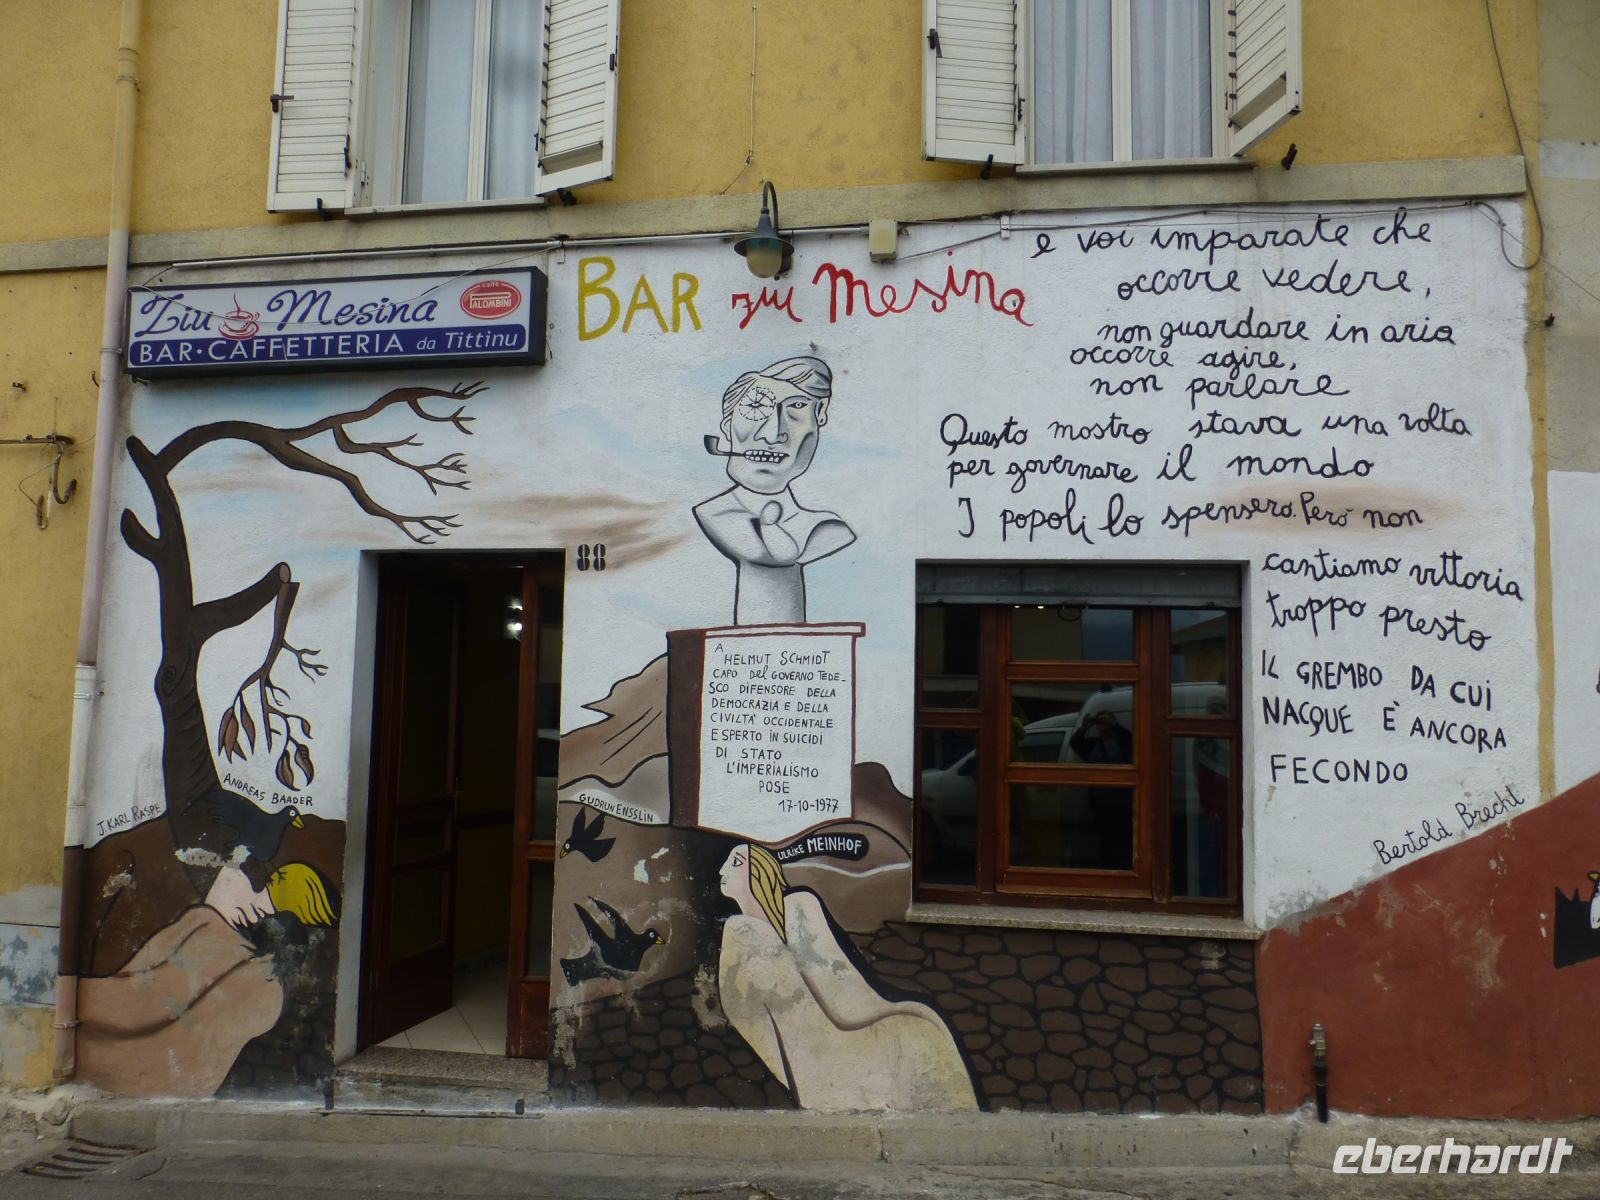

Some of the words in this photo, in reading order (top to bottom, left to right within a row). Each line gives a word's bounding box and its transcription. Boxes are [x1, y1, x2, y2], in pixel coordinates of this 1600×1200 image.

[1077, 229, 1134, 253] voi
[1150, 213, 1349, 265] imparate
[1373, 207, 1432, 245] che
[1117, 265, 1241, 300] occorre
[134, 293, 214, 338] Ziu
[266, 289, 438, 331] Mesina
[577, 256, 701, 342] BAR
[416, 336, 436, 351] da
[445, 331, 518, 350] Tittinu
[1097, 318, 1152, 343] non
[1159, 306, 1310, 349] guardare
[1325, 314, 1369, 344] in
[1380, 316, 1456, 346] aria
[1069, 346, 1174, 367] occorre
[1090, 373, 1164, 396] non
[1185, 373, 1350, 411] parlare
[940, 413, 1028, 456] Questo
[1048, 412, 1152, 444] mostro
[1188, 410, 1302, 438] stava
[1322, 414, 1389, 437] una
[1398, 402, 1472, 436] volta
[947, 459, 995, 488] per
[1005, 455, 1139, 493] governare
[1156, 443, 1197, 481] il
[1226, 446, 1375, 478] mondo
[999, 488, 1095, 545] popoli
[1097, 493, 1145, 537] lo
[1362, 508, 1424, 529] non
[576, 543, 606, 572] 88
[1261, 548, 1402, 582] cantiamo
[1409, 549, 1524, 601] vittoria
[1265, 590, 1366, 637] troppo
[1379, 605, 1492, 651] presto
[715, 643, 723, 653] A
[724, 653, 771, 665] HELMUT
[780, 650, 831, 665] SCHMIDT
[713, 668, 738, 679] CAPO
[771, 670, 814, 681] GOVERNO
[1261, 649, 1280, 679] IL
[1296, 661, 1383, 690] GREMBO
[1411, 664, 1436, 698] DA
[708, 681, 729, 694] SCO
[807, 687, 836, 698] DELLA
[763, 716, 834, 728] OCCIDENTALE
[784, 701, 791, 711] E
[797, 701, 829, 713] DELLA
[1261, 696, 1354, 737] NACQUE
[1409, 717, 1507, 753] ANCORA
[716, 747, 727, 758] DI
[741, 748, 782, 760] STATO
[1270, 754, 1408, 784] FECONDO
[223, 773, 266, 801] ANDREAS
[271, 793, 313, 806] BAADER
[579, 793, 615, 812] GUDRUN
[759, 781, 790, 794] POSE
[107, 812, 131, 831] KARL
[131, 803, 161, 822] RASPE
[778, 798, 839, 814] 17-10-1977
[806, 836, 863, 854] MEINHOF
[1373, 818, 1452, 865] Bertold
